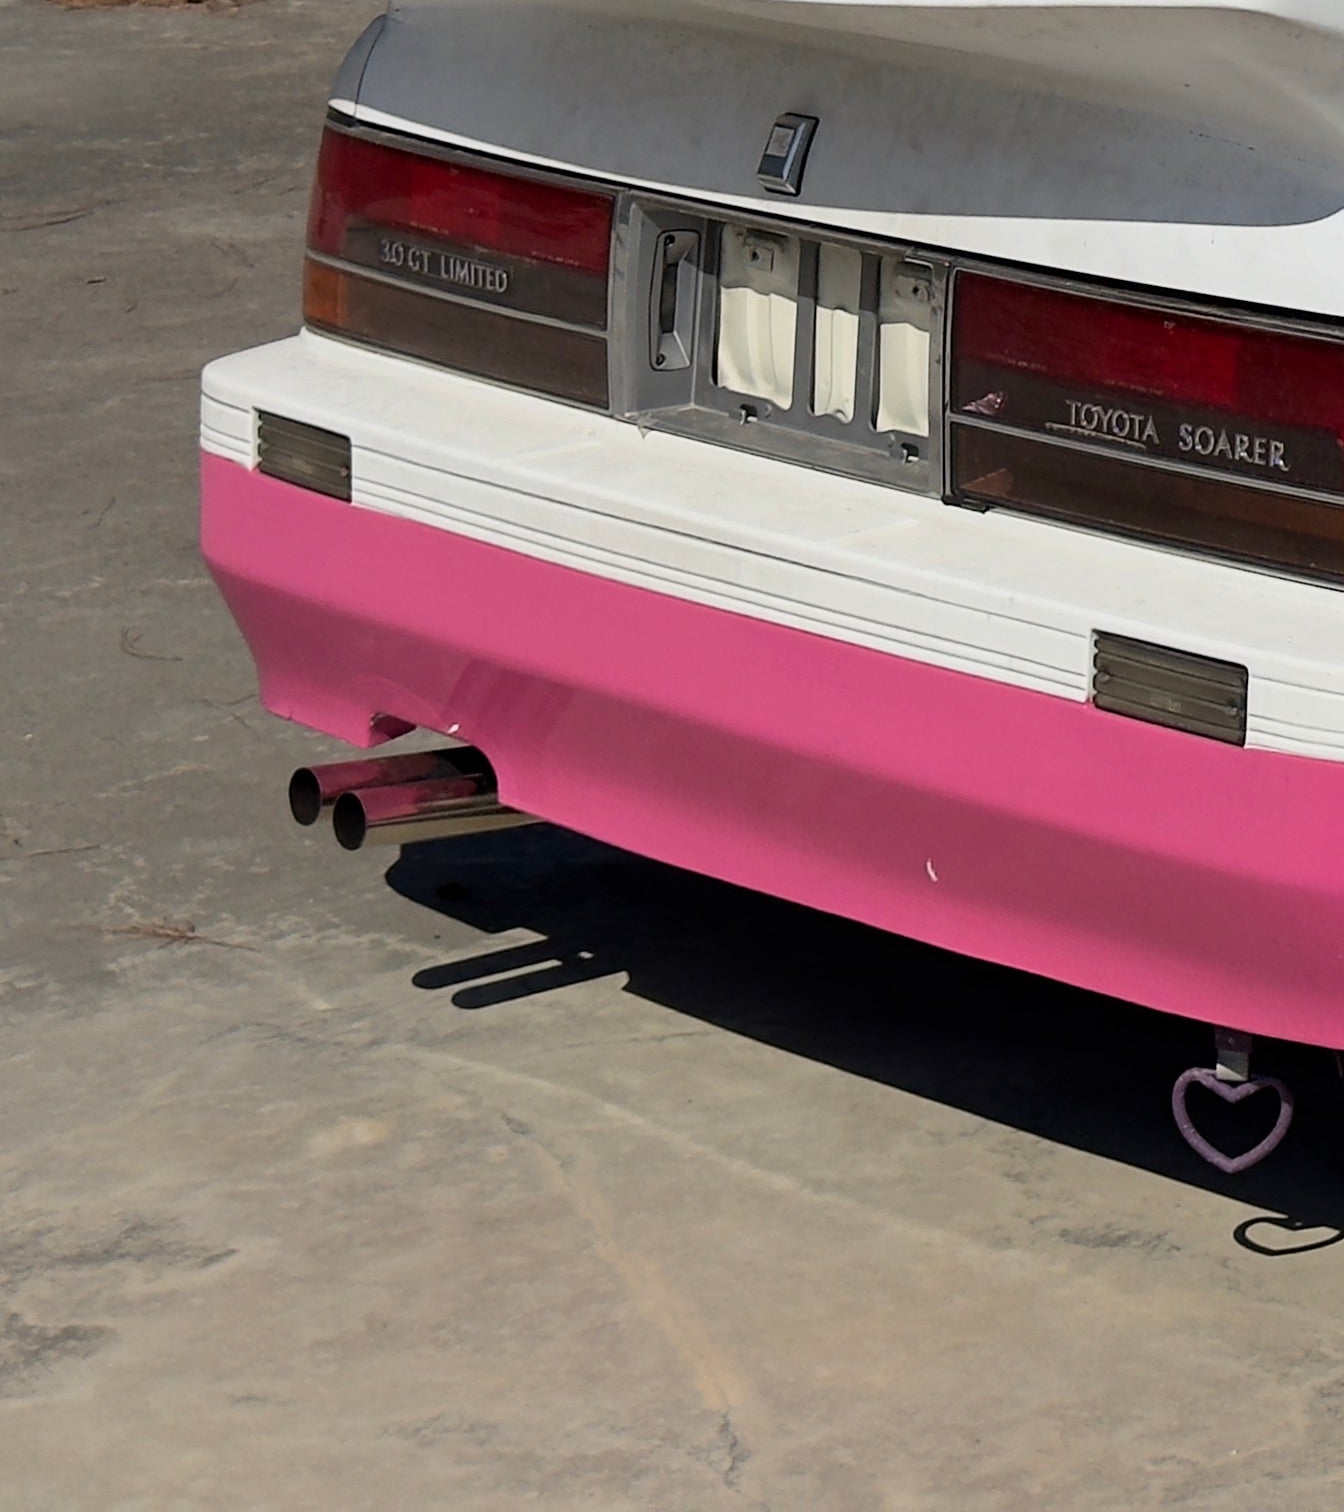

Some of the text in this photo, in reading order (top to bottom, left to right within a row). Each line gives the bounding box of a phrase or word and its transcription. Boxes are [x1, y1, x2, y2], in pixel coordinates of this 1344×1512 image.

[407, 246, 432, 274] GT
[440, 254, 509, 294] LIMITED
[1065, 398, 1293, 473] TOYOTA SOARER
